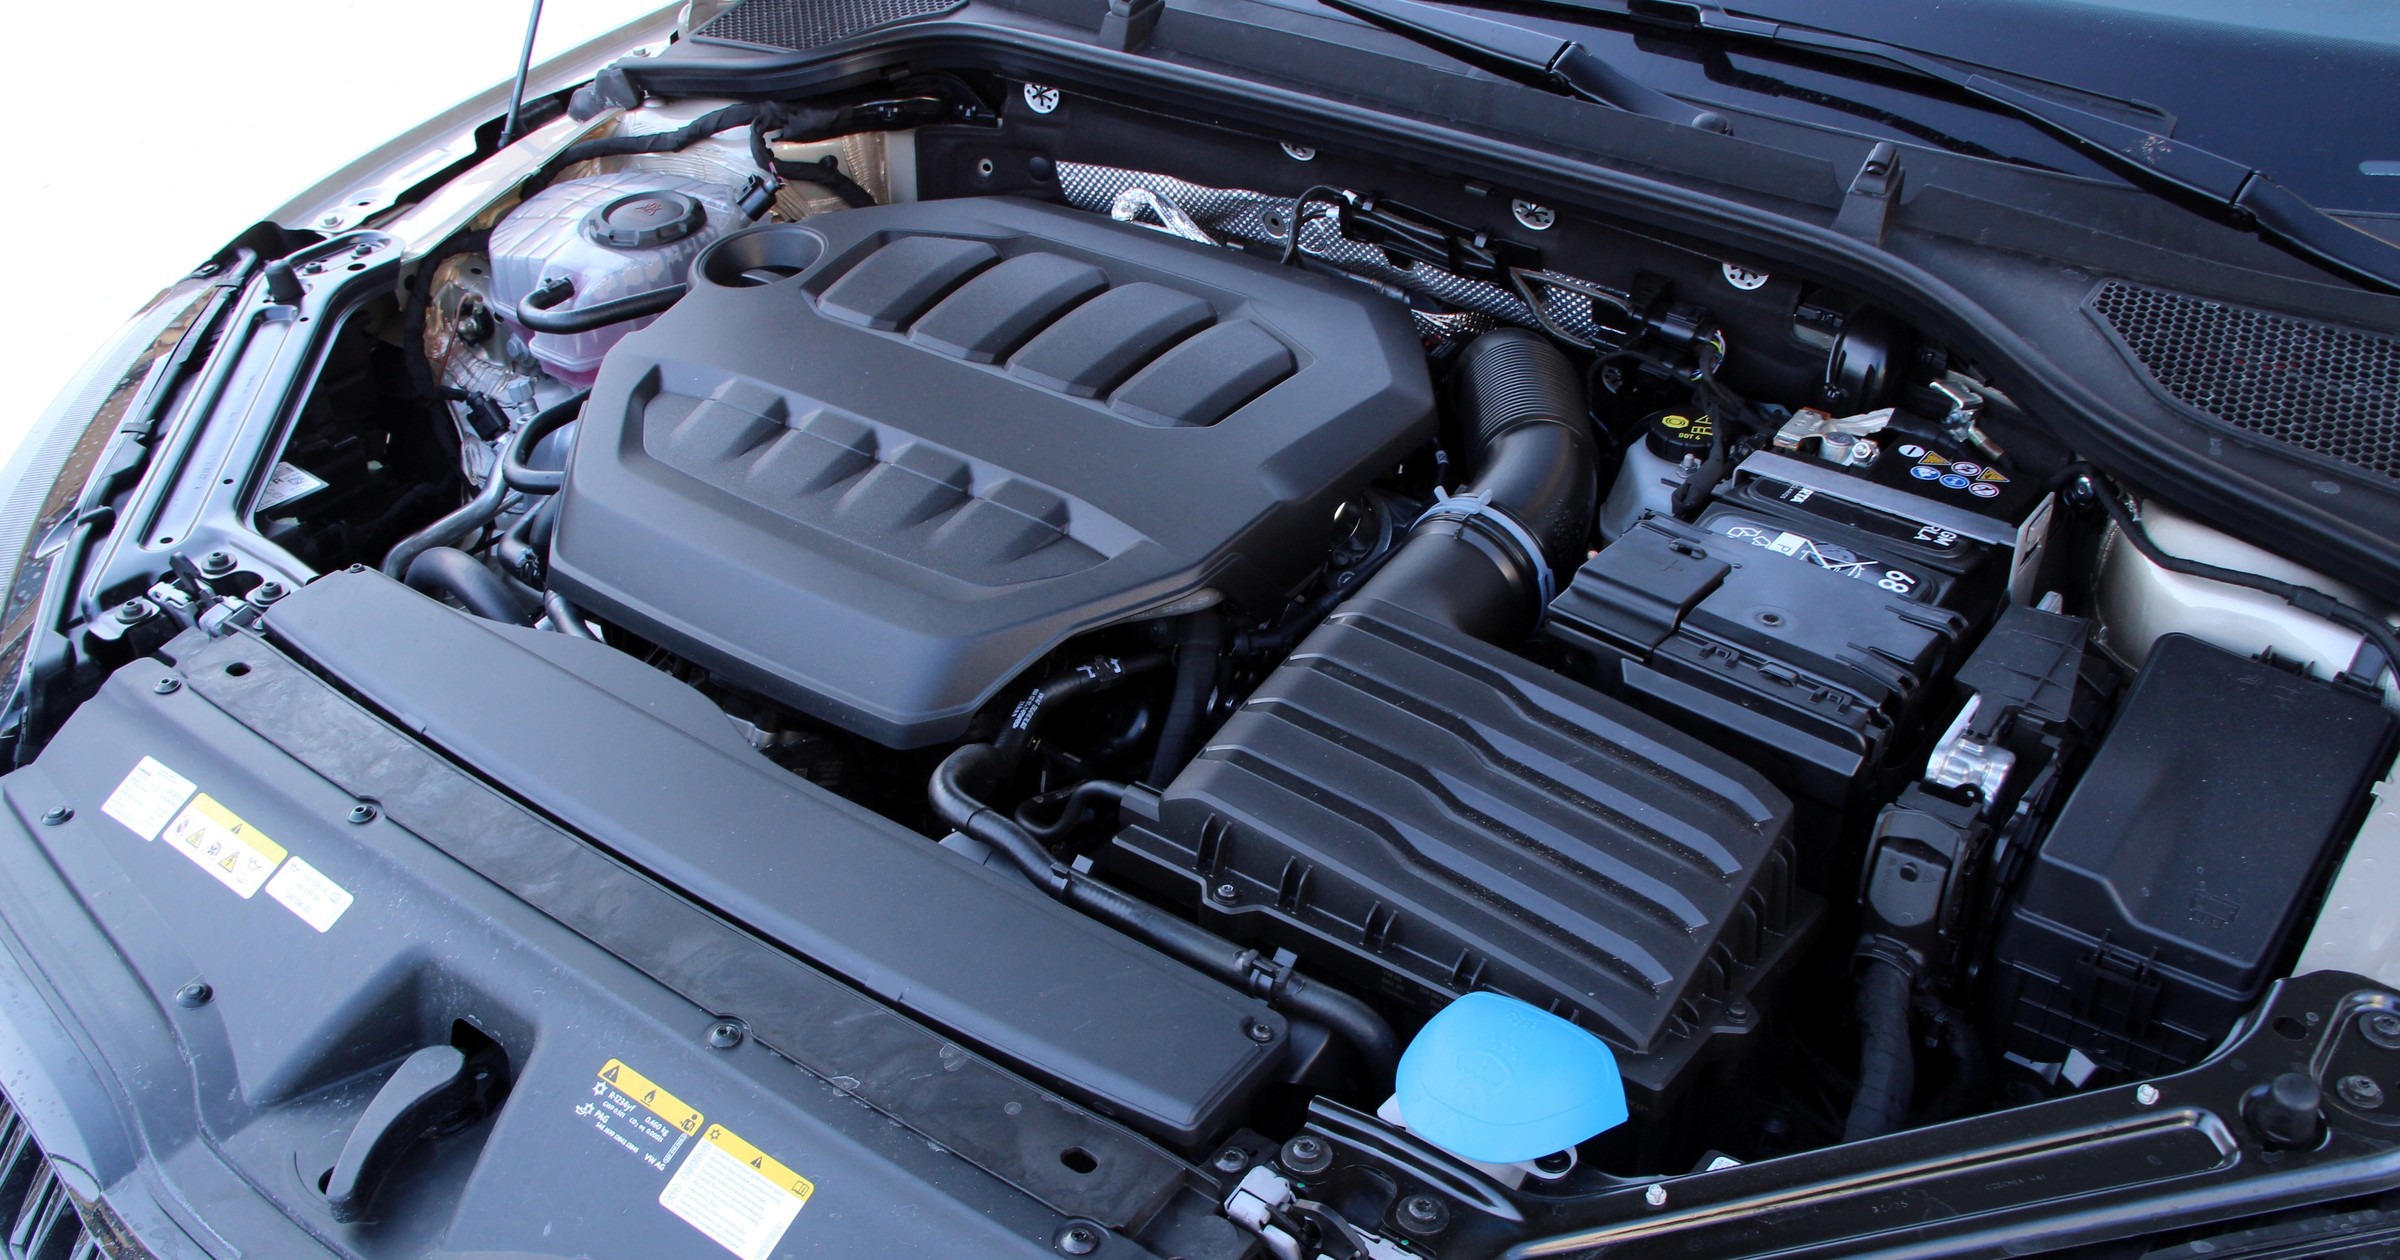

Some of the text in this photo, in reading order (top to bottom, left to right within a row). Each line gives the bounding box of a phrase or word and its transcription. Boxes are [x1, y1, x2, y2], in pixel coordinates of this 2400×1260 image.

[1678, 432, 1694, 440] DOT
[1789, 487, 1815, 504] RTA
[1913, 526, 1940, 541] RLA
[1933, 531, 1957, 547] GM
[1878, 570, 1916, 593] 68
[594, 1109, 610, 1124] PAG
[607, 1090, 670, 1137] R-1234yf 0.460 kg
[644, 1152, 657, 1165] VW
[654, 1161, 666, 1171] AG
